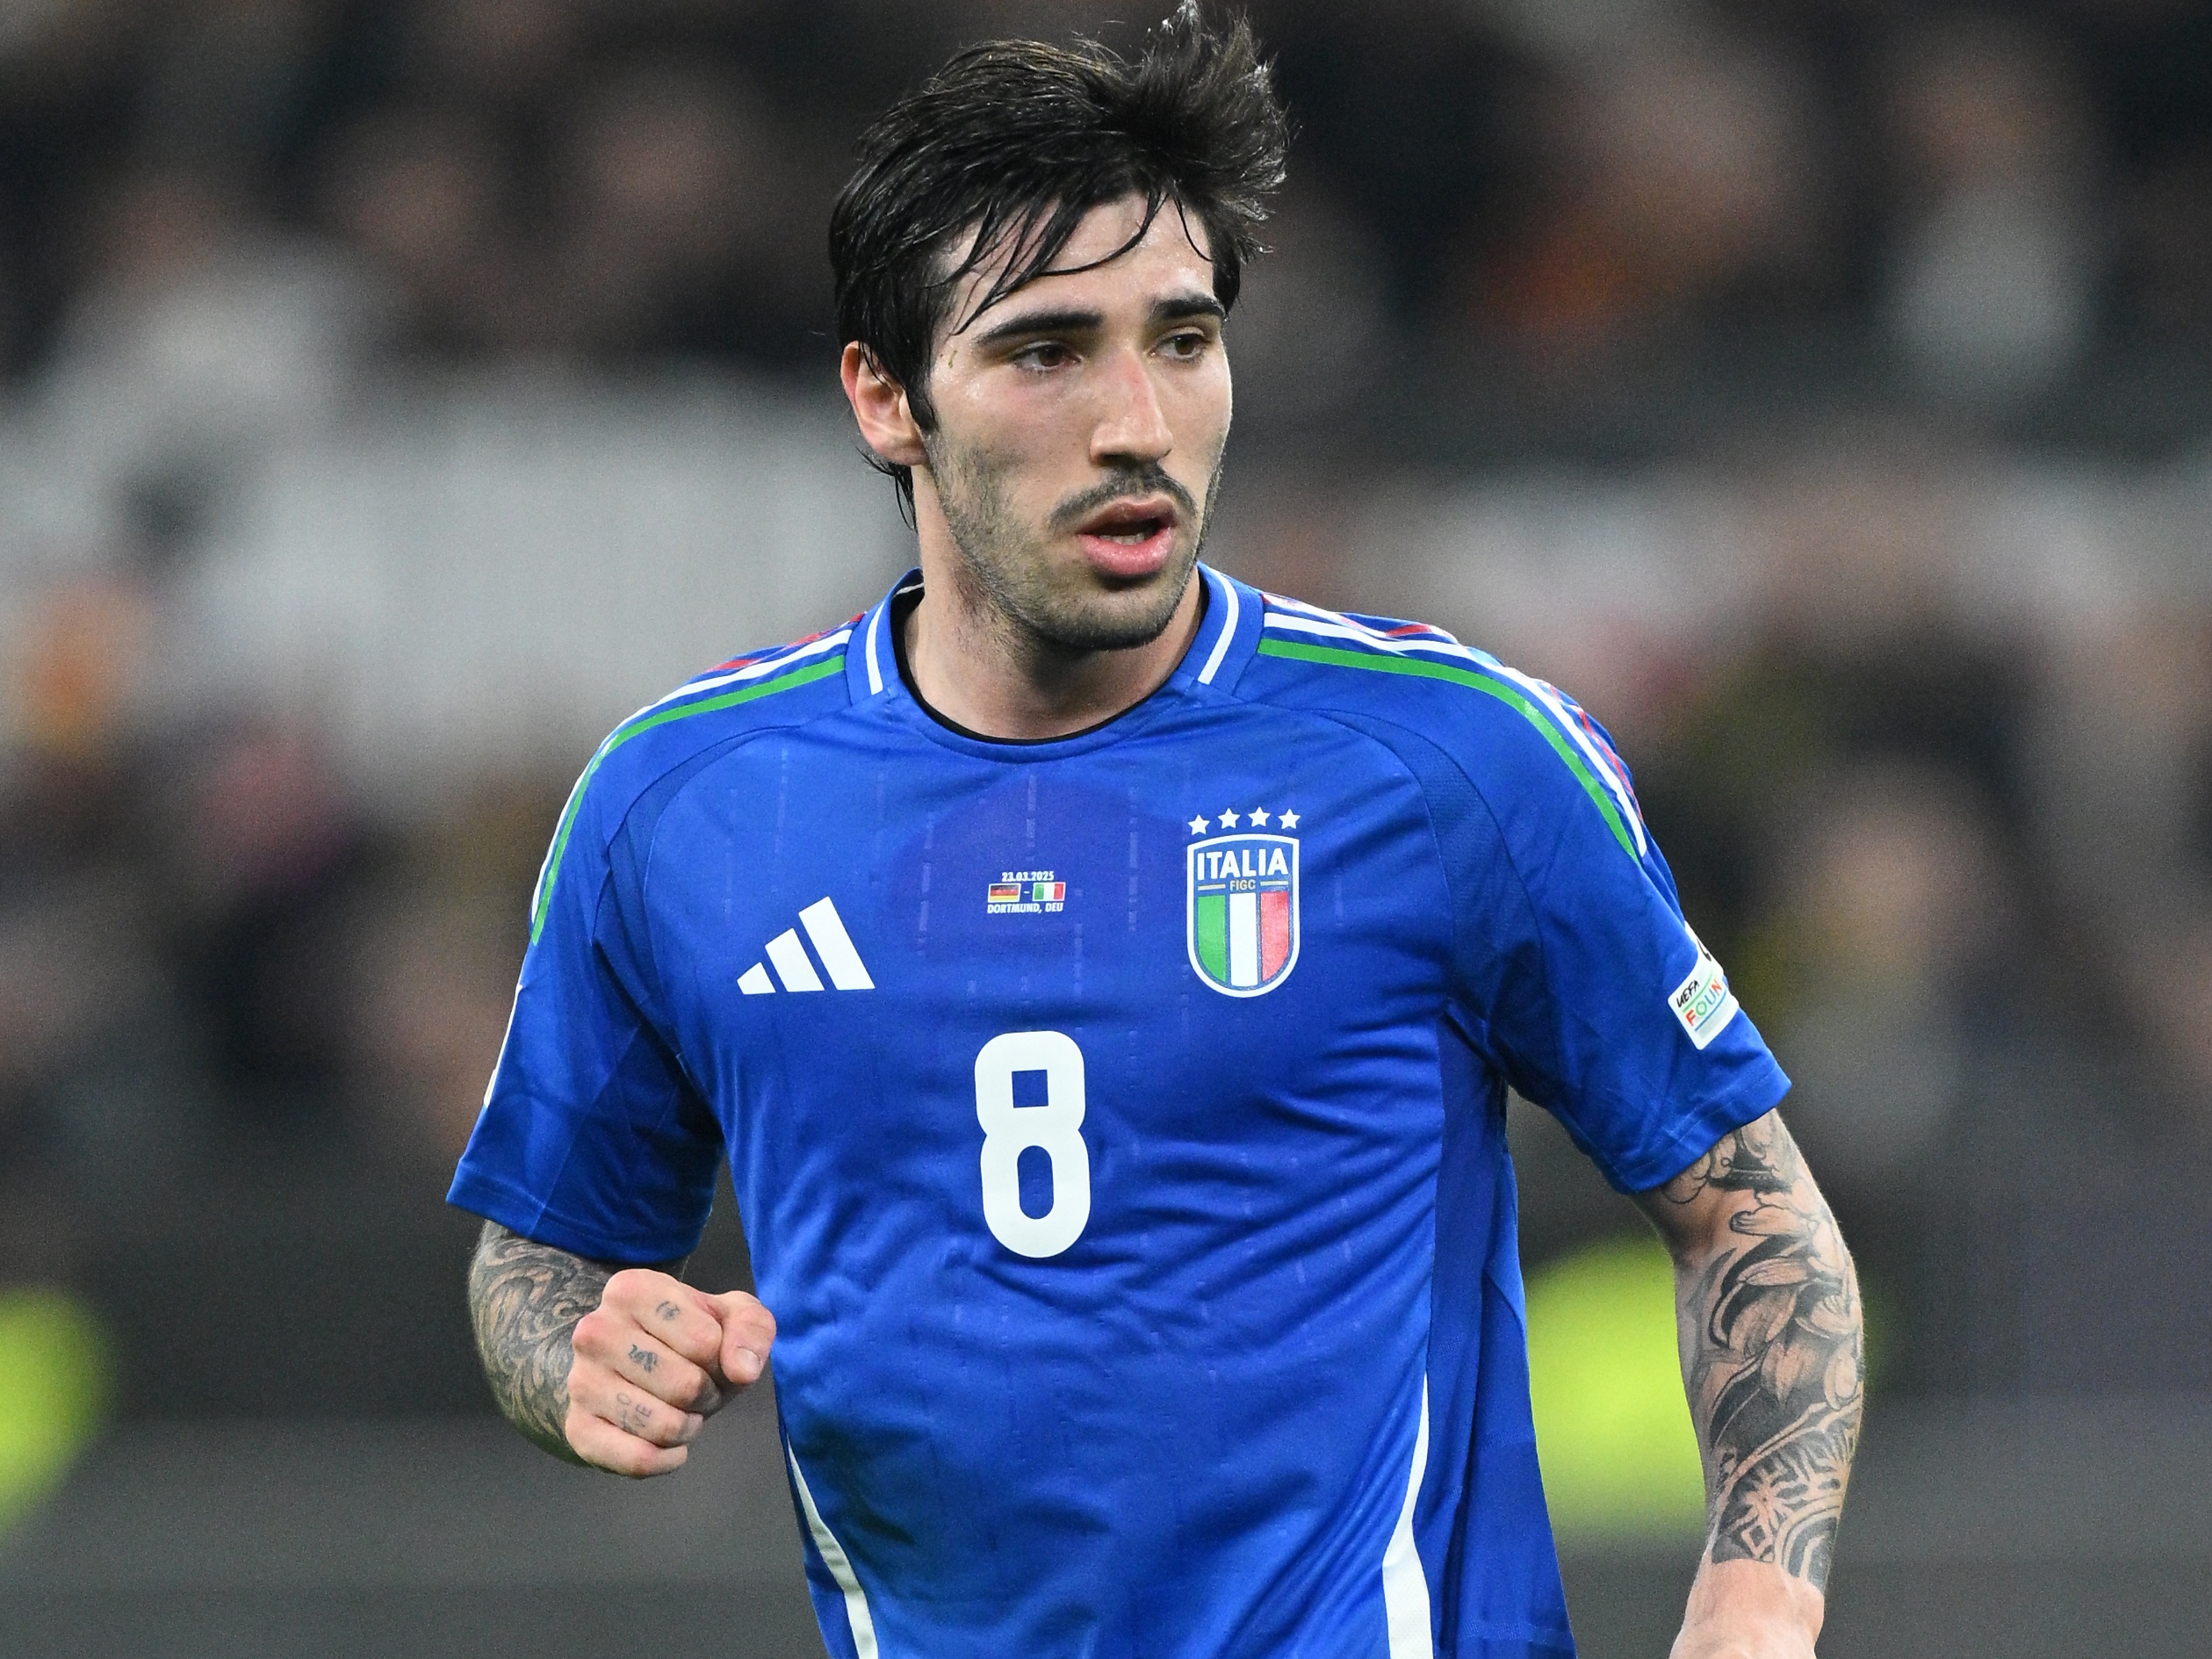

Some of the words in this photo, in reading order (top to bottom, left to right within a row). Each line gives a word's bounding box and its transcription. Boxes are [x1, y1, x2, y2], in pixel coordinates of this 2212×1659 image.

[1197, 848, 1289, 881] ITALIA
[1002, 871, 1055, 882] 23.03.2025
[1229, 879, 1256, 891] FIGC
[987, 904, 1042, 913] DORTMUND,
[1045, 902, 1063, 912] DEU
[1676, 979, 1700, 1008] UEFA
[975, 1030, 1091, 1258] 8
